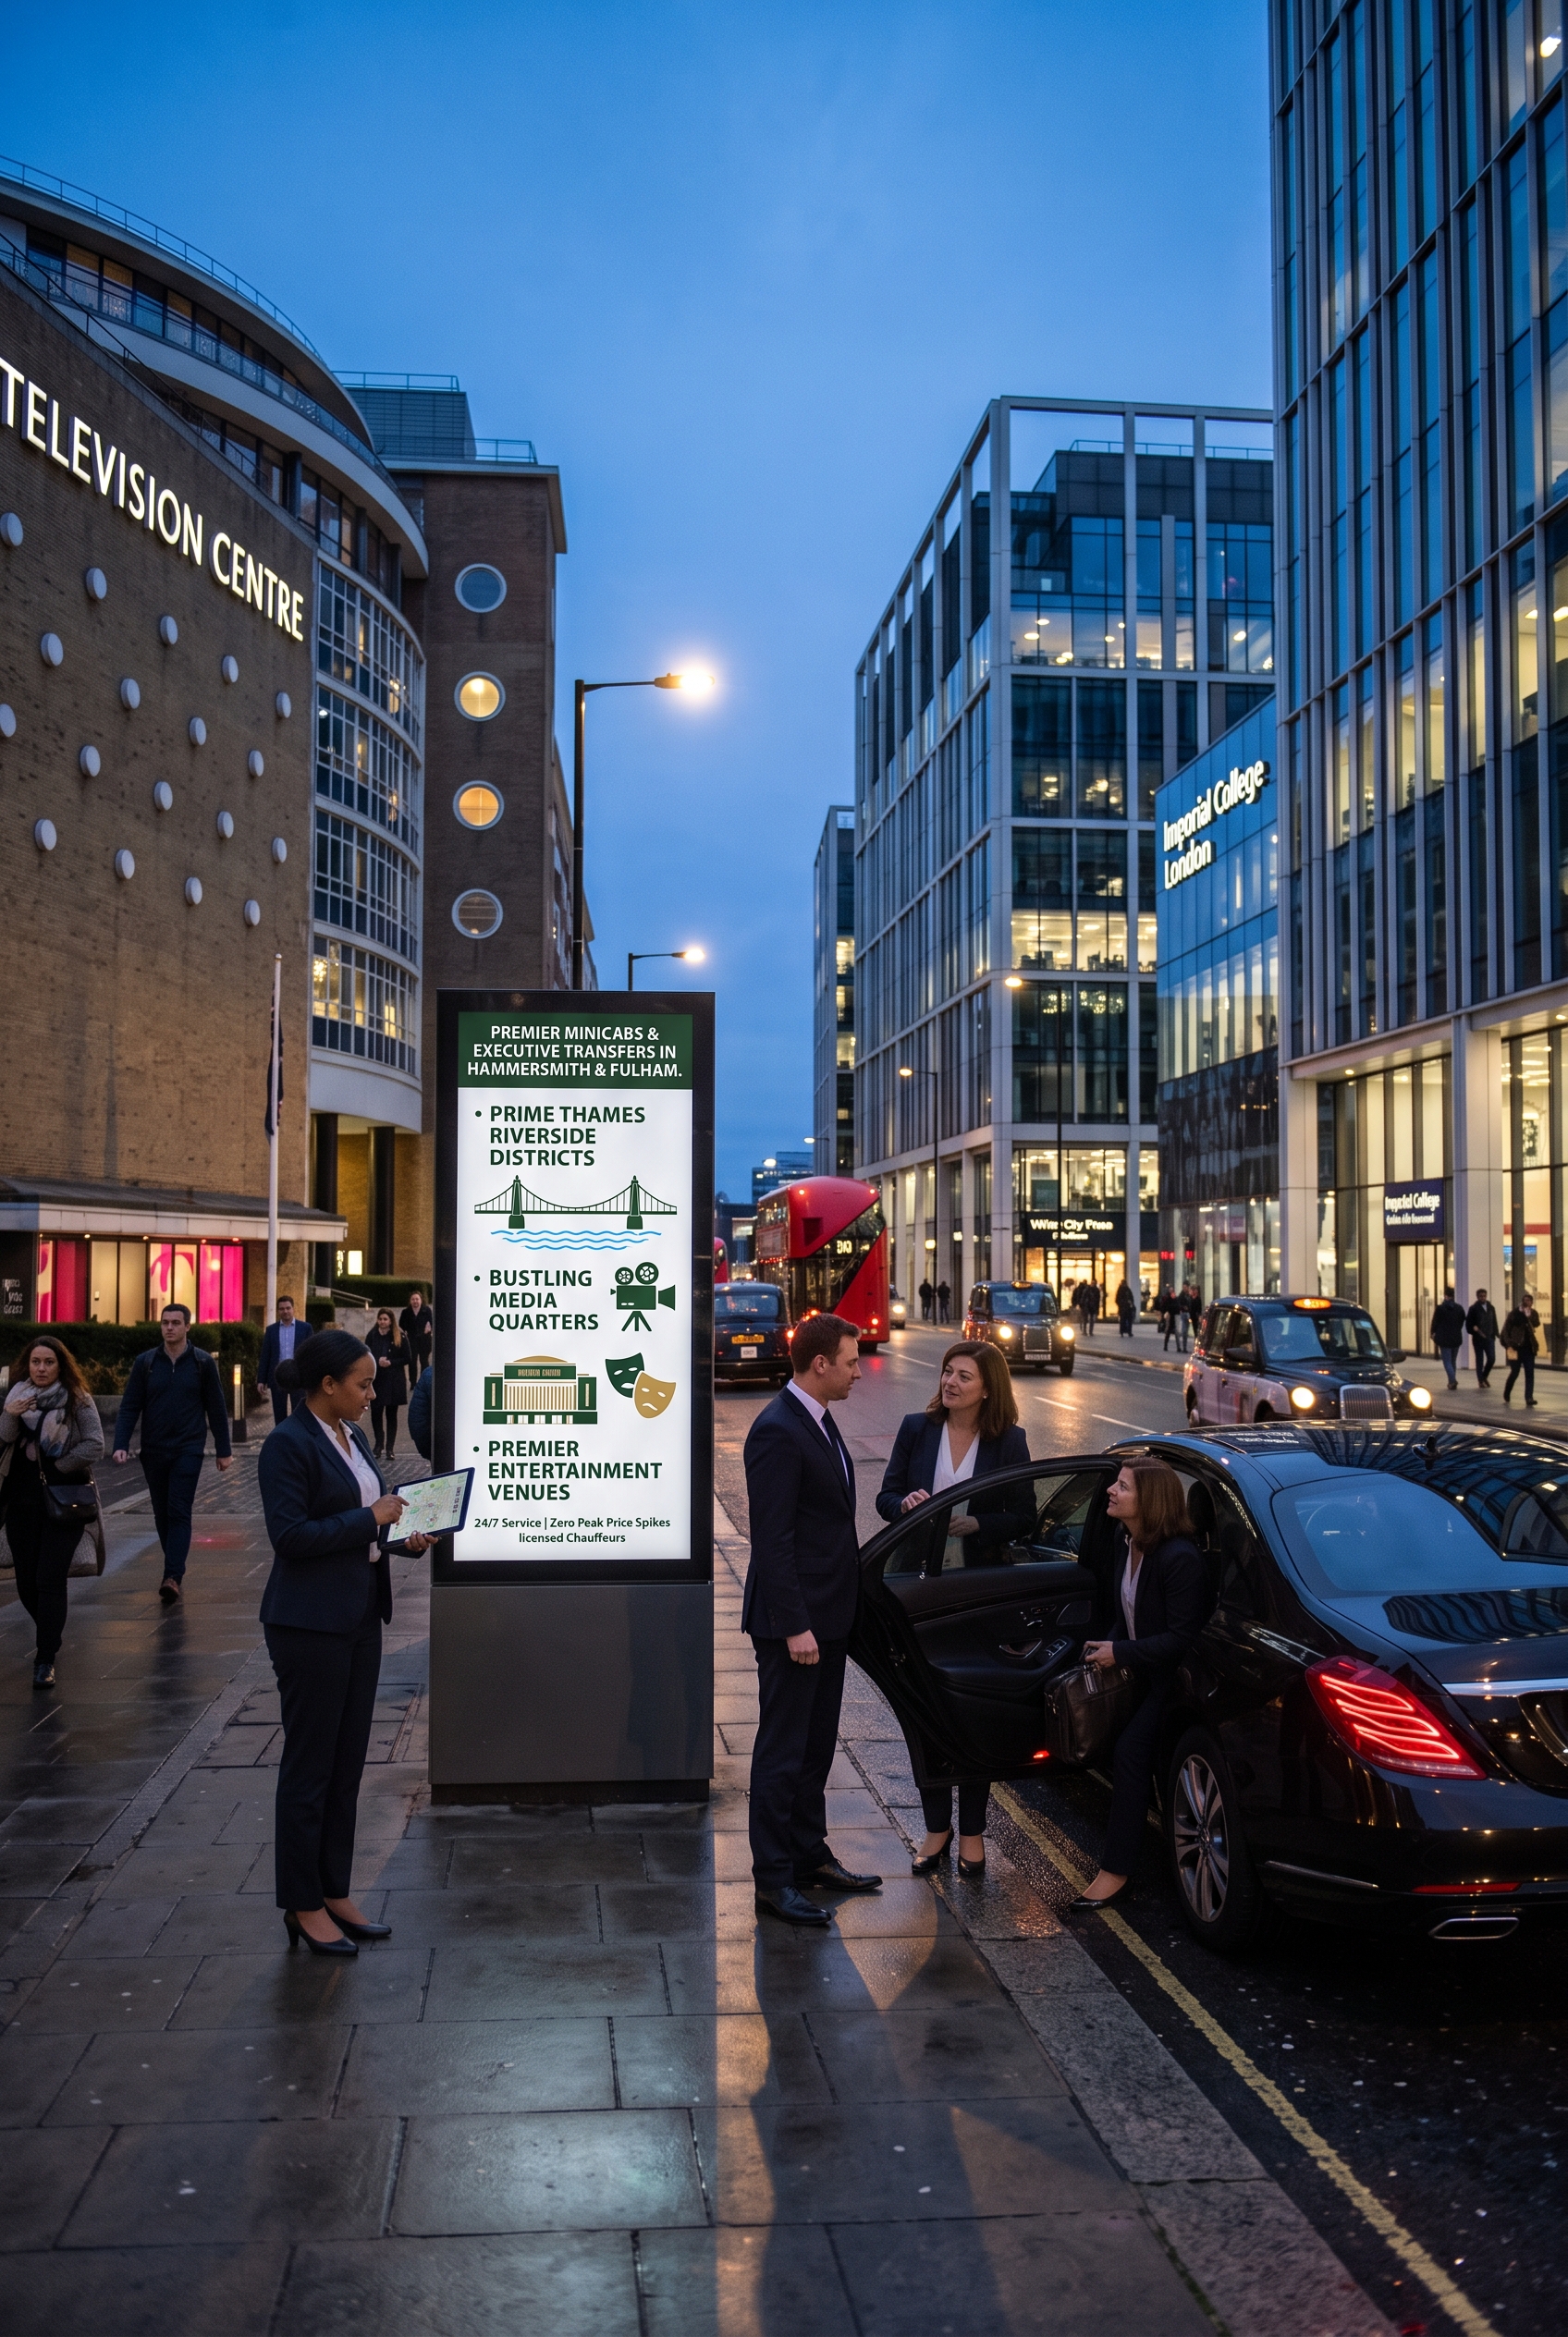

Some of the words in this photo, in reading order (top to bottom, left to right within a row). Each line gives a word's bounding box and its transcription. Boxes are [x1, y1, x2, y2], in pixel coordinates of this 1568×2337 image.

[0, 357, 203, 566] TELEVISION
[210, 532, 304, 642] CENTRE
[1213, 760, 1265, 814] College
[1164, 838, 1212, 889] London
[491, 1025, 561, 1040] PREMIER
[564, 1026, 643, 1041] MINICABS
[647, 1026, 659, 1041] &
[473, 1043, 560, 1058] EXECUTIVE
[563, 1044, 655, 1059] TRANSFERS
[659, 1045, 676, 1059] IN
[467, 1061, 591, 1077] HAMMERSMITH
[594, 1062, 606, 1077] &
[610, 1062, 682, 1077] FULHAM.
[490, 1105, 555, 1122] PRIME
[558, 1106, 645, 1123] THAMES
[490, 1127, 596, 1144] RIVERSIDE
[490, 1149, 595, 1167] DISTRICTS
[489, 1269, 593, 1287] BUSTLING
[489, 1291, 557, 1309] MEDIA
[488, 1313, 599, 1332] QUARTERS
[488, 1440, 580, 1457] PREMIER
[488, 1462, 663, 1479] ENTERTAINMENT
[487, 1484, 570, 1501] VENUES
[473, 1517, 499, 1529] 24/7
[501, 1517, 542, 1528] Service
[549, 1517, 575, 1528] Zero
[578, 1517, 604, 1528] Peak
[606, 1517, 633, 1528] Price
[635, 1516, 671, 1530] Spikes
[519, 1532, 564, 1543] licensed
[566, 1532, 626, 1543] Chauffeurs
